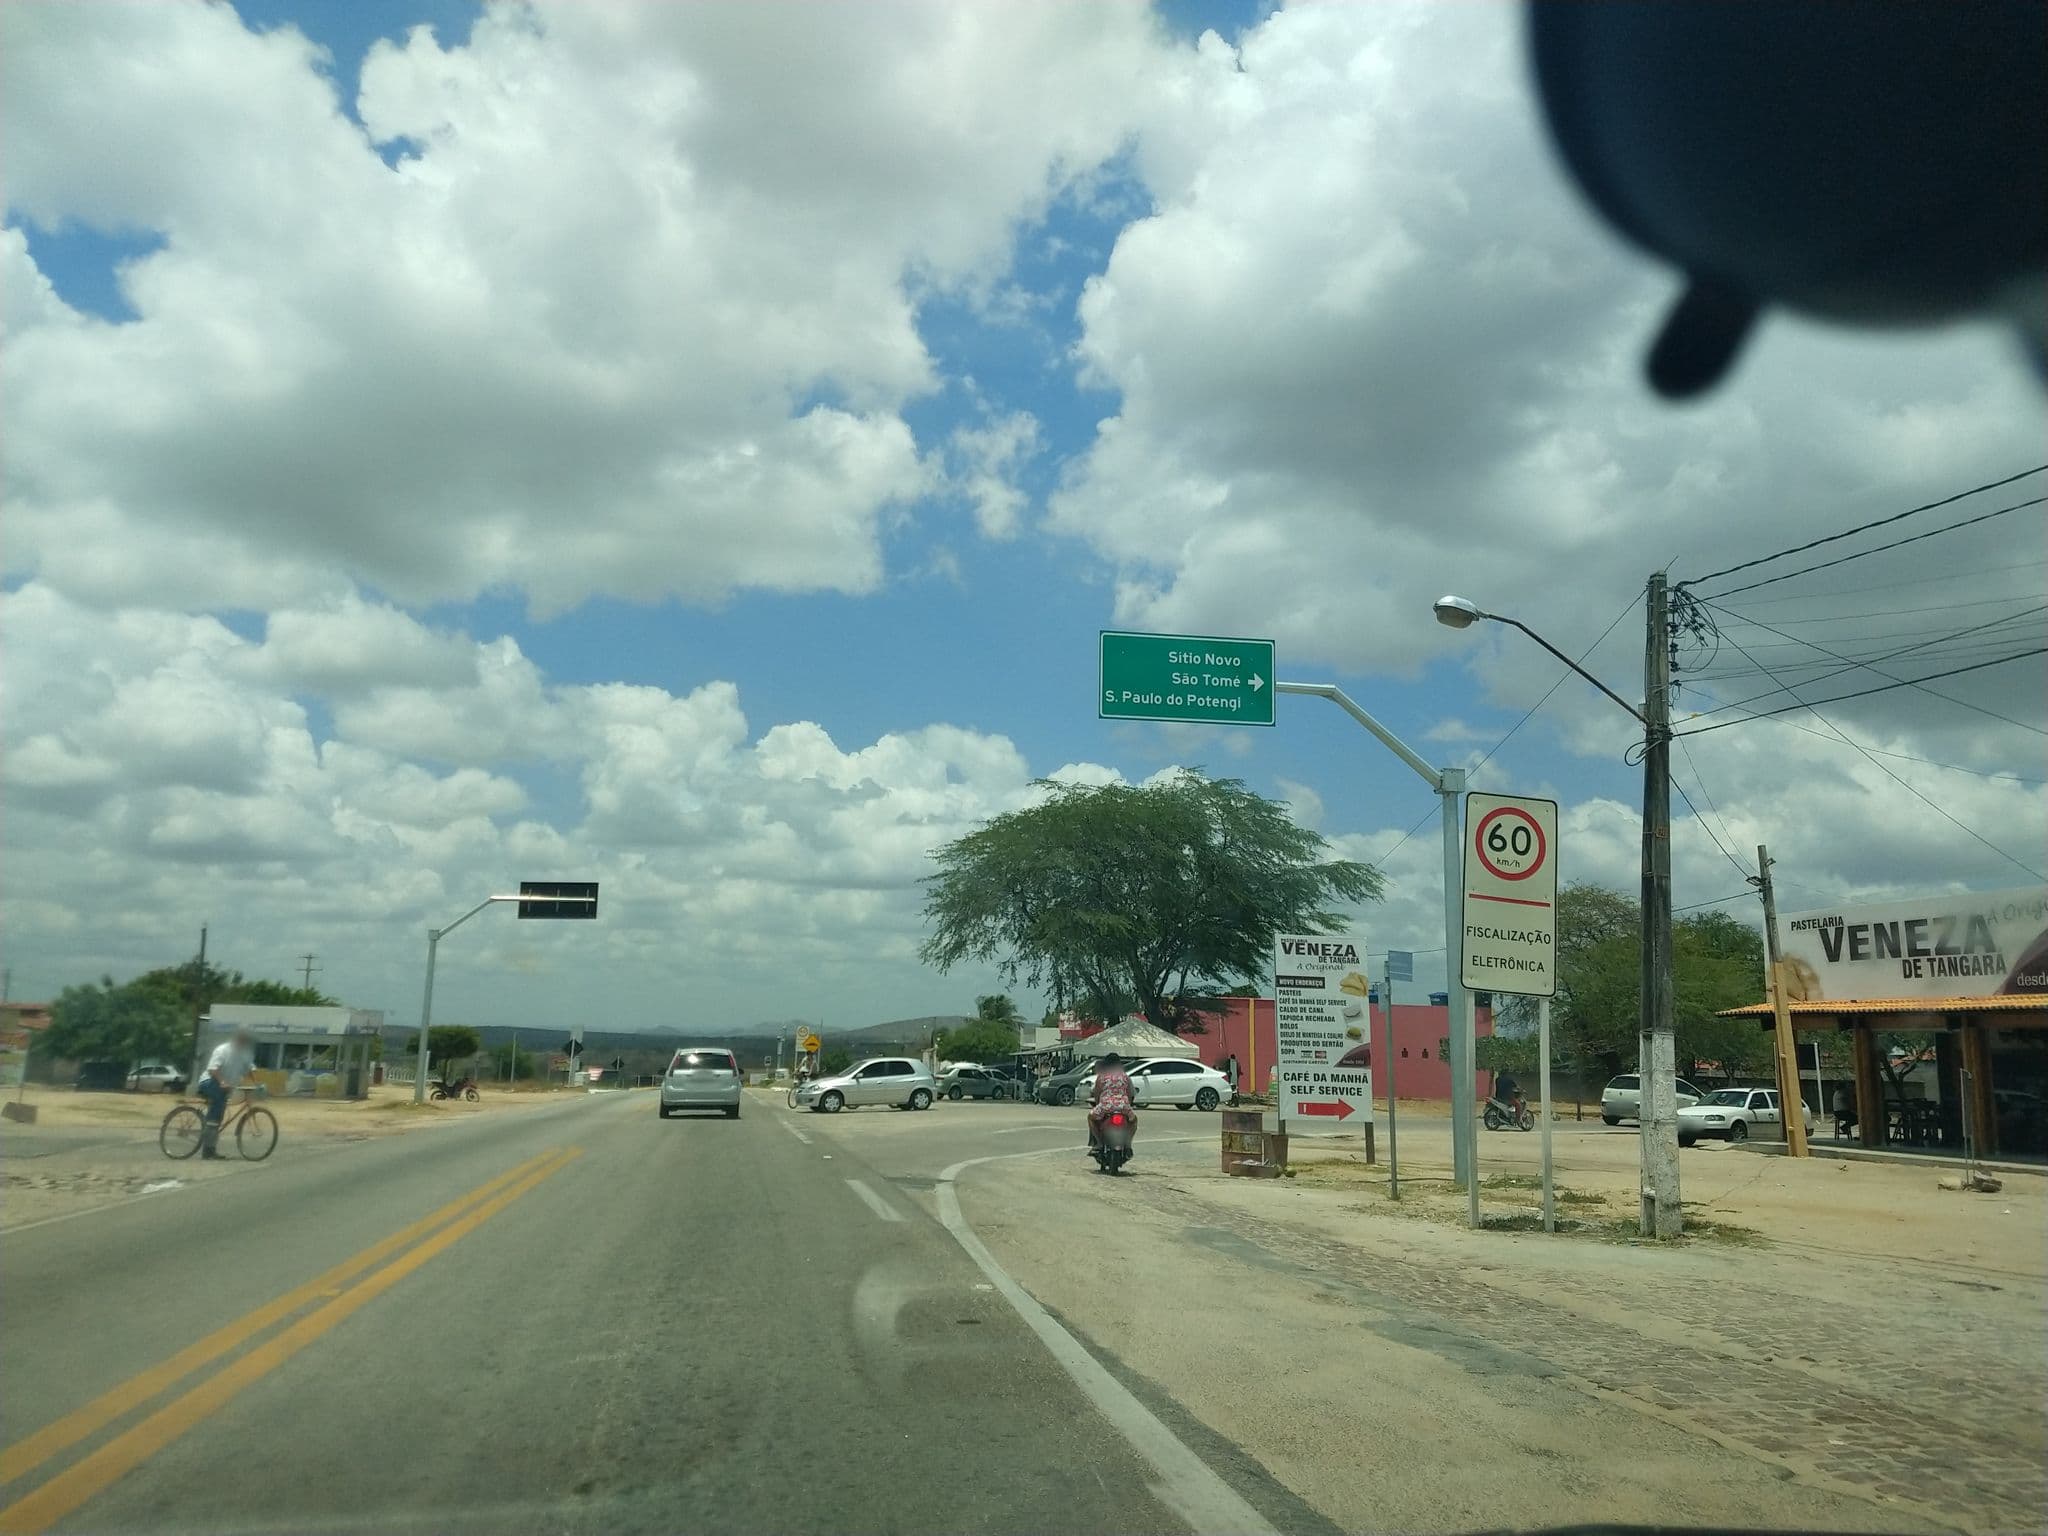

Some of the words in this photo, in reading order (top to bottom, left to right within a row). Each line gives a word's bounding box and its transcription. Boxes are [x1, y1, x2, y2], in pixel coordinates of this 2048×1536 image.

[1168, 651, 1201, 665] Sítio
[1205, 653, 1241, 667] Novo
[1172, 672, 1199, 685] São
[1203, 674, 1241, 688] Tomé
[1105, 690, 1118, 703] S.
[1122, 691, 1162, 705] Paulo
[1166, 693, 1183, 706] do
[1187, 695, 1241, 711] Potengi
[1488, 822, 1532, 857] 60
[1496, 857, 1521, 868] km/h
[1791, 915, 1844, 931] PASTELARIA
[1466, 925, 1551, 946] FISCALIZAÇÃO
[1818, 914, 1997, 963] VENEZA
[1281, 942, 1357, 957] VENEZA
[1472, 955, 1545, 973] ELETRÔNICA
[1902, 957, 1923, 979] DE
[2016, 972, 2048, 987] desd
[1321, 1040, 1344, 1048] SERTÃO
[1283, 1070, 1310, 1082] CAFÉ
[1313, 1073, 1327, 1083] DA
[1330, 1072, 1369, 1084] MANHÃ
[1290, 1085, 1315, 1095] SELF
[1318, 1086, 1363, 1096] SERVICE
